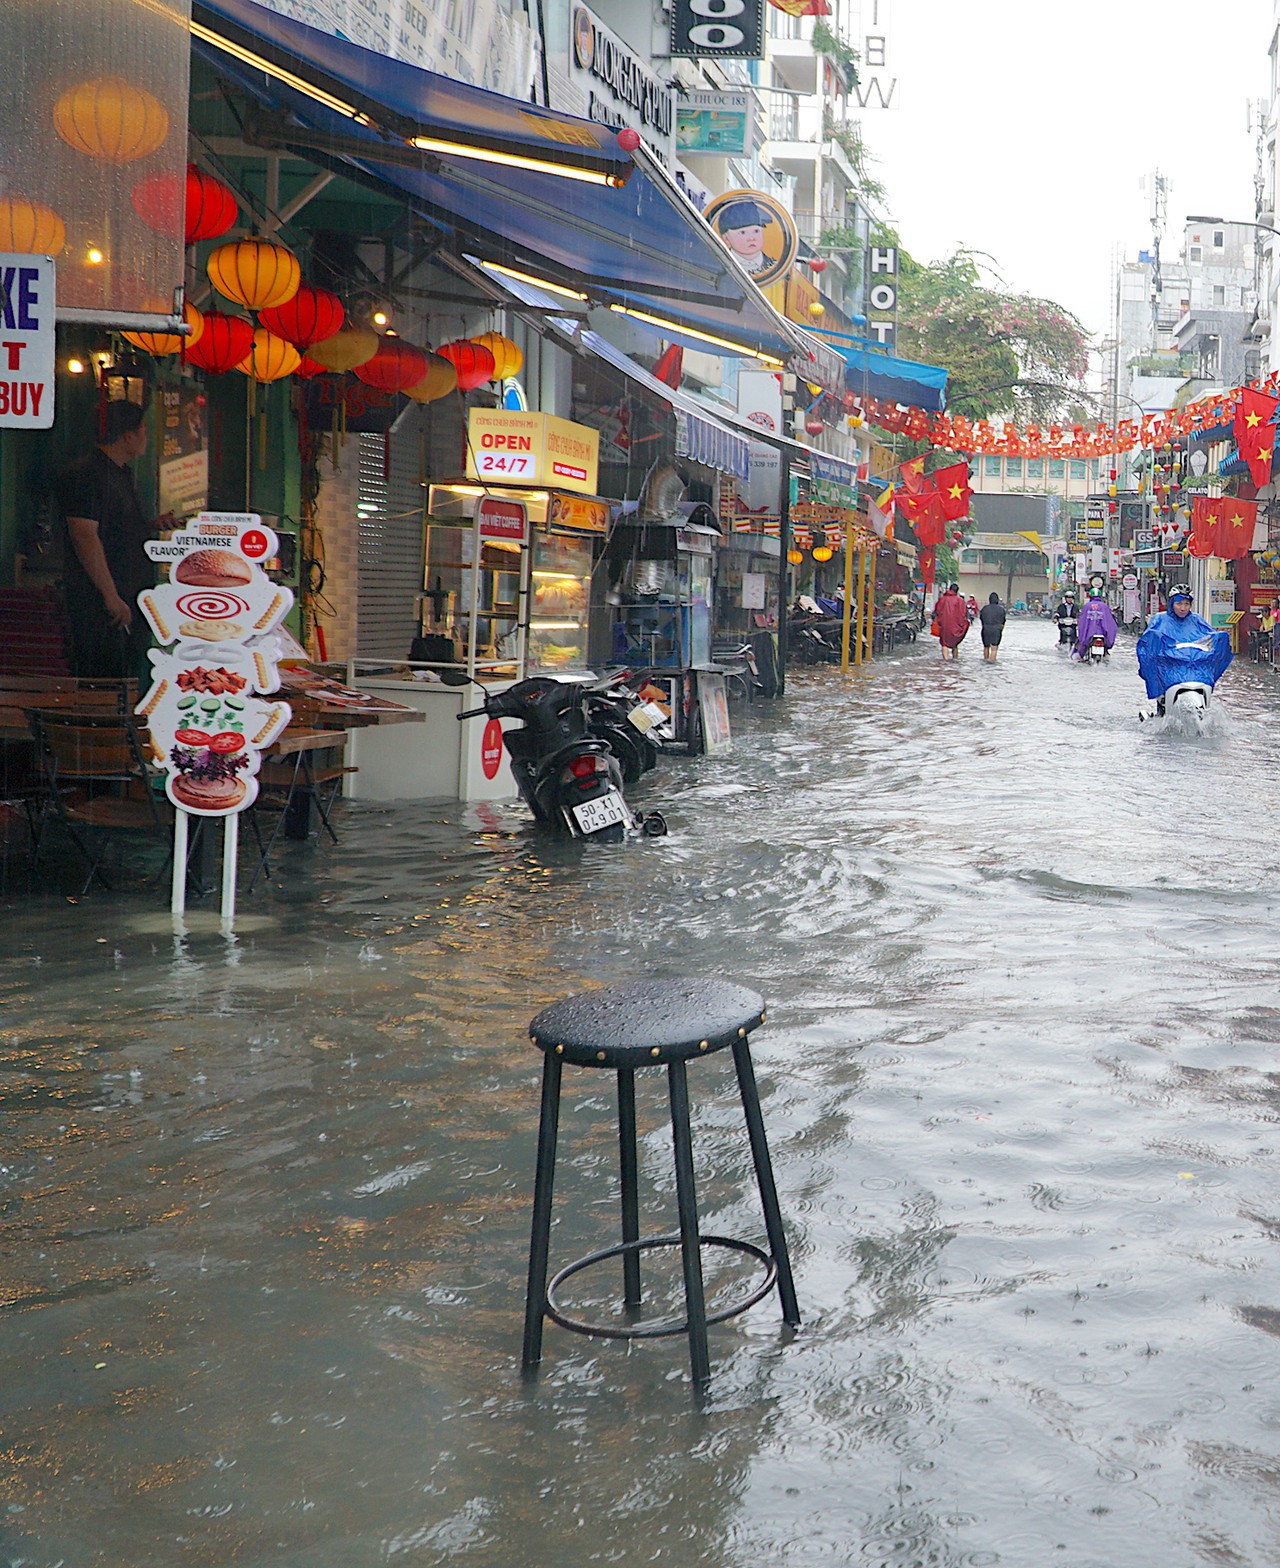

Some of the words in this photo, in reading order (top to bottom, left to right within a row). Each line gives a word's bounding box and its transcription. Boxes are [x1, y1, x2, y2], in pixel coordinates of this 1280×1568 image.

[481, 433, 531, 451] OPEN
[483, 456, 528, 473] 24/7
[176, 536, 231, 547] VIETNAMESE
[1137, 532, 1153, 541] GS
[581, 797, 615, 818] 50-X1
[581, 806, 625, 831] 049.01
